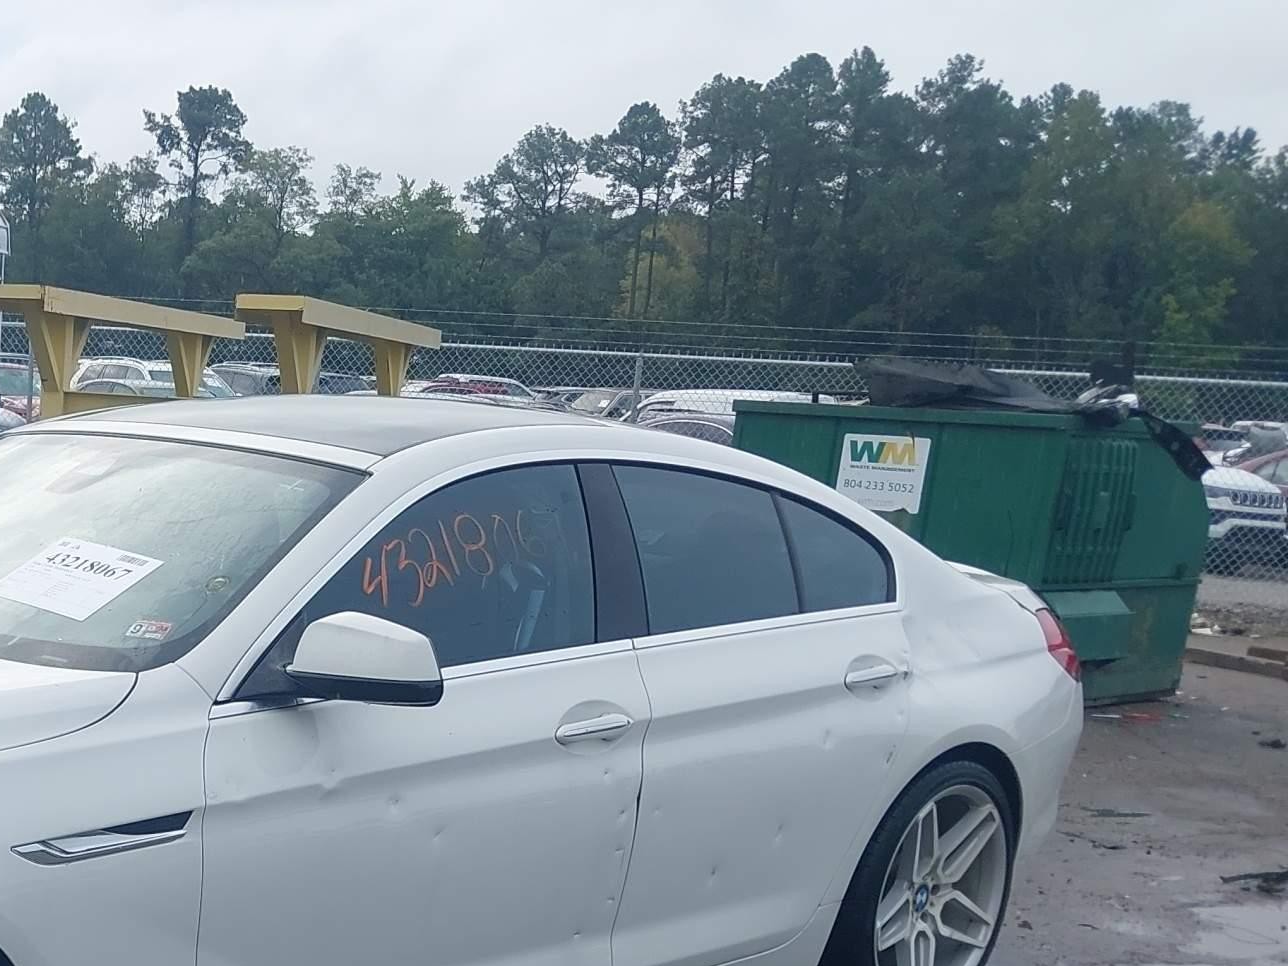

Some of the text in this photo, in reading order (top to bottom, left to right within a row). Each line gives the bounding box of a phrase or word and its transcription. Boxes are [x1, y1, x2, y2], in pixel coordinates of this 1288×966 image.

[850, 440, 916, 464] WM
[843, 478, 914, 493] 804 233 5052
[45, 552, 133, 581] 43218067
